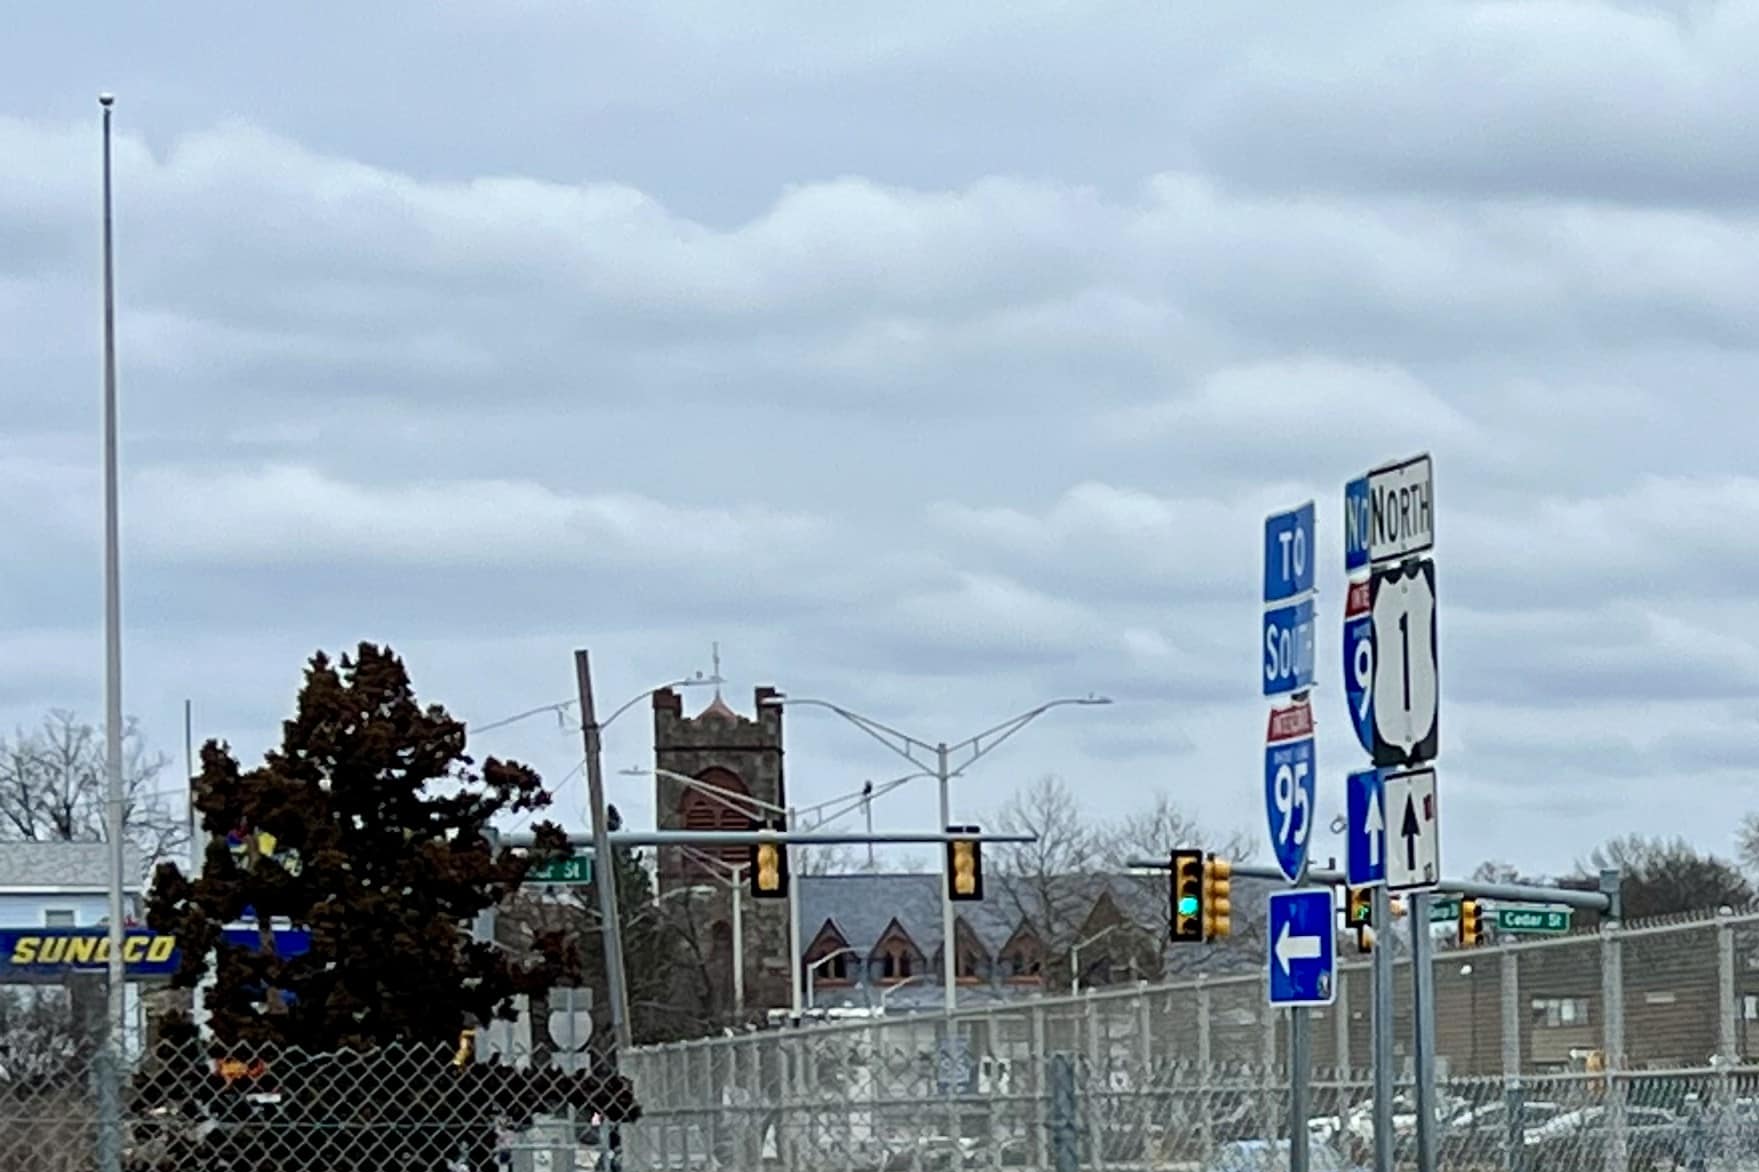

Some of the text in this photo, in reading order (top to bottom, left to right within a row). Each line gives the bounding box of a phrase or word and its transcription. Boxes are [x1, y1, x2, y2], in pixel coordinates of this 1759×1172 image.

[1371, 481, 1430, 546] NORTH
[1279, 527, 1306, 582] TO
[1266, 622, 1312, 681] SOU
[1354, 639, 1372, 721] 9
[1398, 611, 1410, 712] 1
[1274, 763, 1309, 845] 95
[1504, 911, 1562, 927] Cedar St
